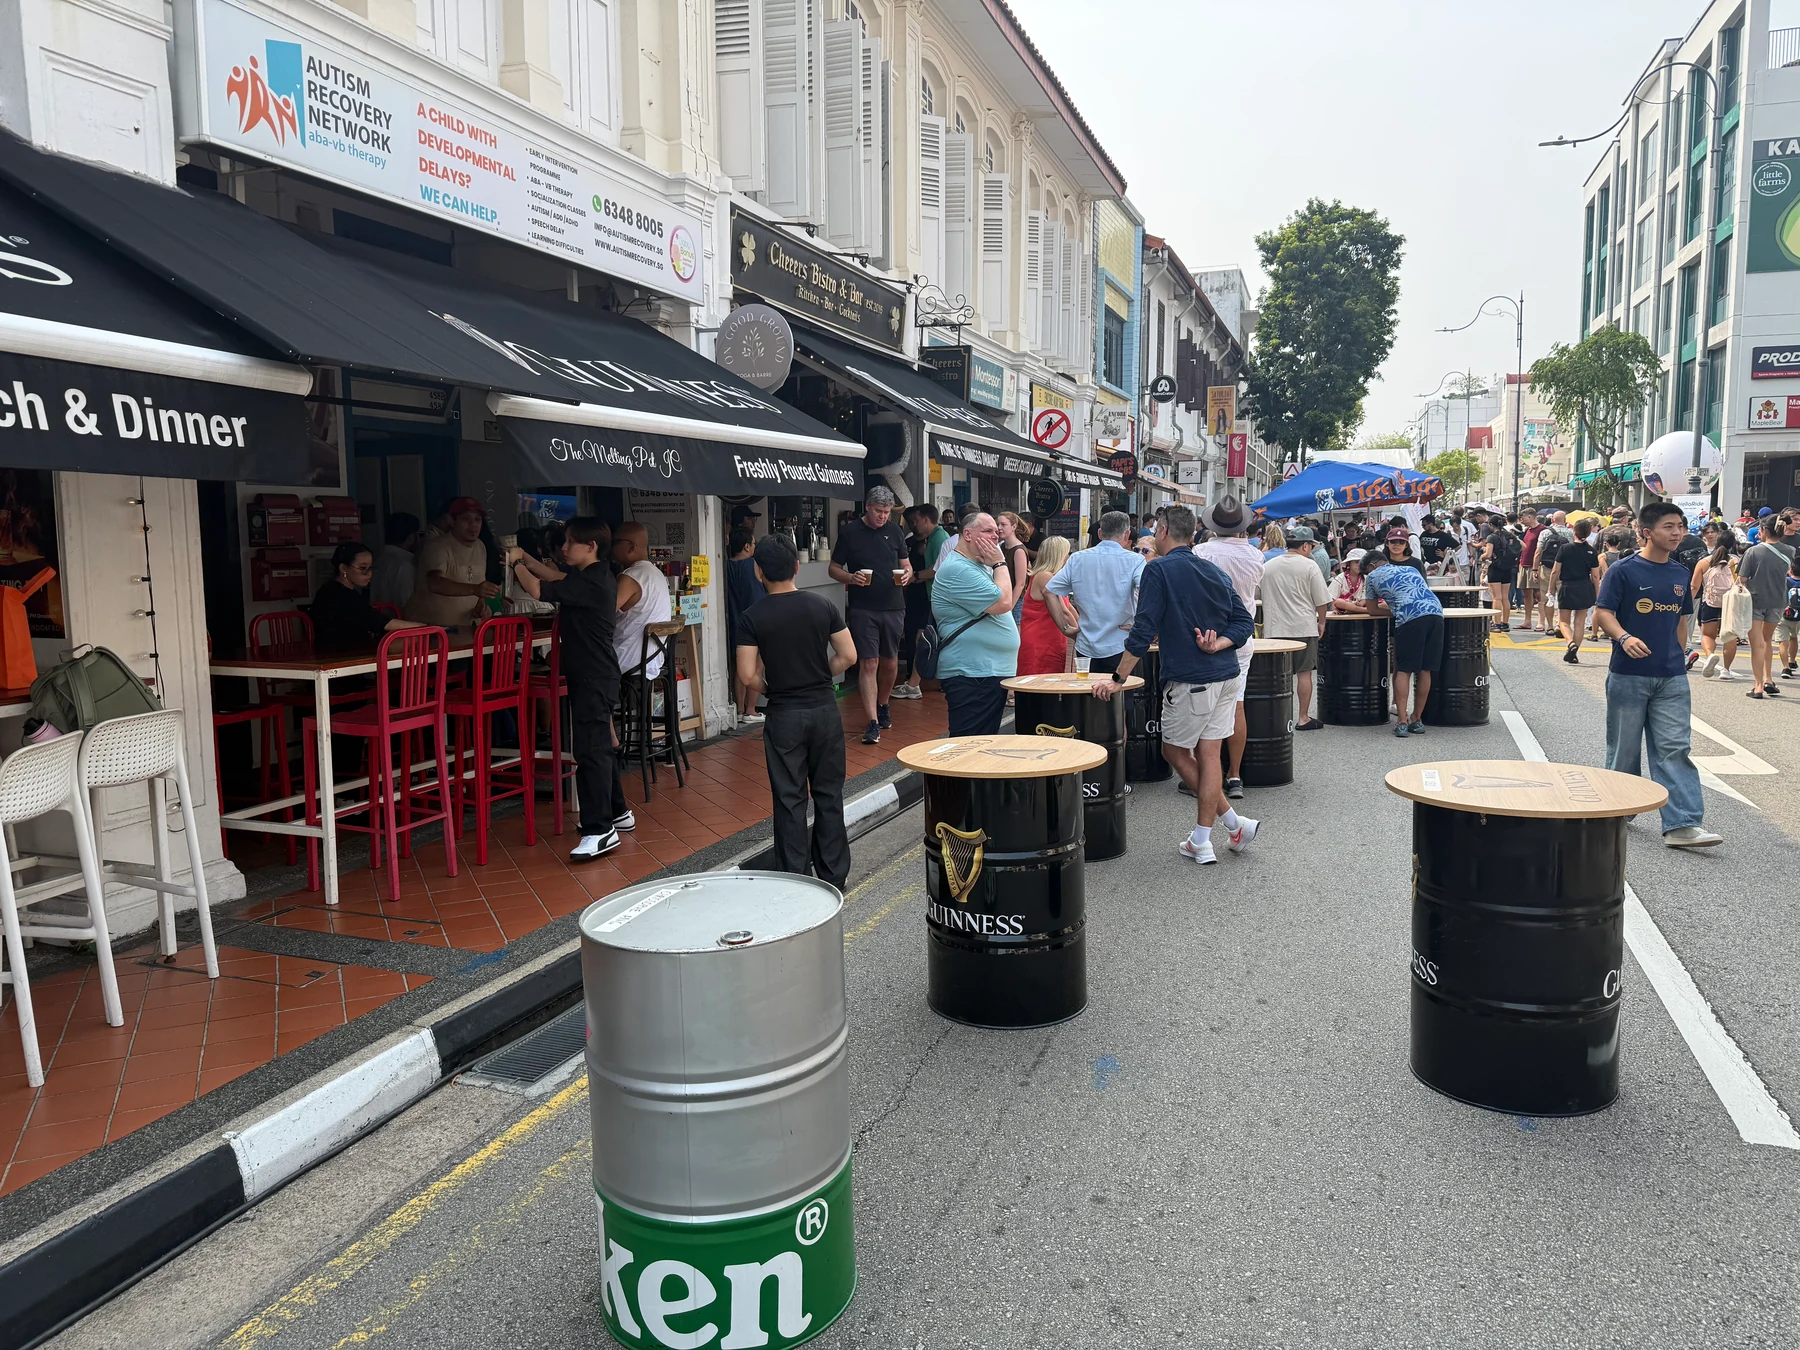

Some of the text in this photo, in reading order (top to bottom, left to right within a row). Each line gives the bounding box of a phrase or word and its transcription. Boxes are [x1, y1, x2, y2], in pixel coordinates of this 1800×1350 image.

[306, 55, 371, 99] AUTISM
[307, 79, 392, 130] RECOVERY
[308, 105, 392, 154] NETWORK
[417, 102, 497, 149] A CHILD WITH
[309, 131, 386, 170] aba-vb therapy
[418, 129, 516, 182] DEVELOPMENTAL
[529, 148, 578, 175] EARLY INTERVENTION
[1768, 139, 1800, 156] KA
[419, 156, 471, 188] DELAYS?
[530, 162, 561, 181] PROGRAMME
[1758, 178, 1786, 186] farms
[1763, 171, 1782, 179] little
[530, 176, 541, 186] ABA
[545, 182, 552, 191] VB
[552, 184, 573, 199] THERAPY
[420, 184, 500, 225] WE CAN HELP.
[531, 190, 586, 218] SOCIALIZATION CLASSES
[531, 204, 550, 217] AUTISM
[604, 198, 663, 238] 6348 8005
[531, 218, 565, 235] SPEECH DELAY
[594, 222, 663, 256] INFO@AUTISMRECOVERY.SG
[531, 231, 584, 255] LEARNING DIFFICULTIES
[594, 238, 663, 270] WWW.AUTISMRECOVERY.SG
[769, 242, 808, 280] Cheeers
[811, 262, 837, 294] Bistro
[839, 279, 848, 299] &
[849, 282, 863, 305] Bar
[798, 284, 860, 323] Kitchen Bar Cocktails
[723, 312, 785, 365] ON GOOD GROUND
[975, 365, 1002, 389] Montessori
[64, 388, 103, 436] &
[111, 393, 248, 447] Dinner
[550, 438, 583, 462] The
[582, 439, 633, 473] Melting
[733, 455, 855, 486] Freshly Poured Guinness
[1340, 477, 1390, 504] Tige
[1399, 476, 1440, 498] Tige
[1654, 602, 1682, 614] Spotify
[675, 657, 687, 666] ELP
[1146, 720, 1162, 734] GU
[1082, 783, 1100, 798] SS
[926, 894, 1024, 936] GUINNESS
